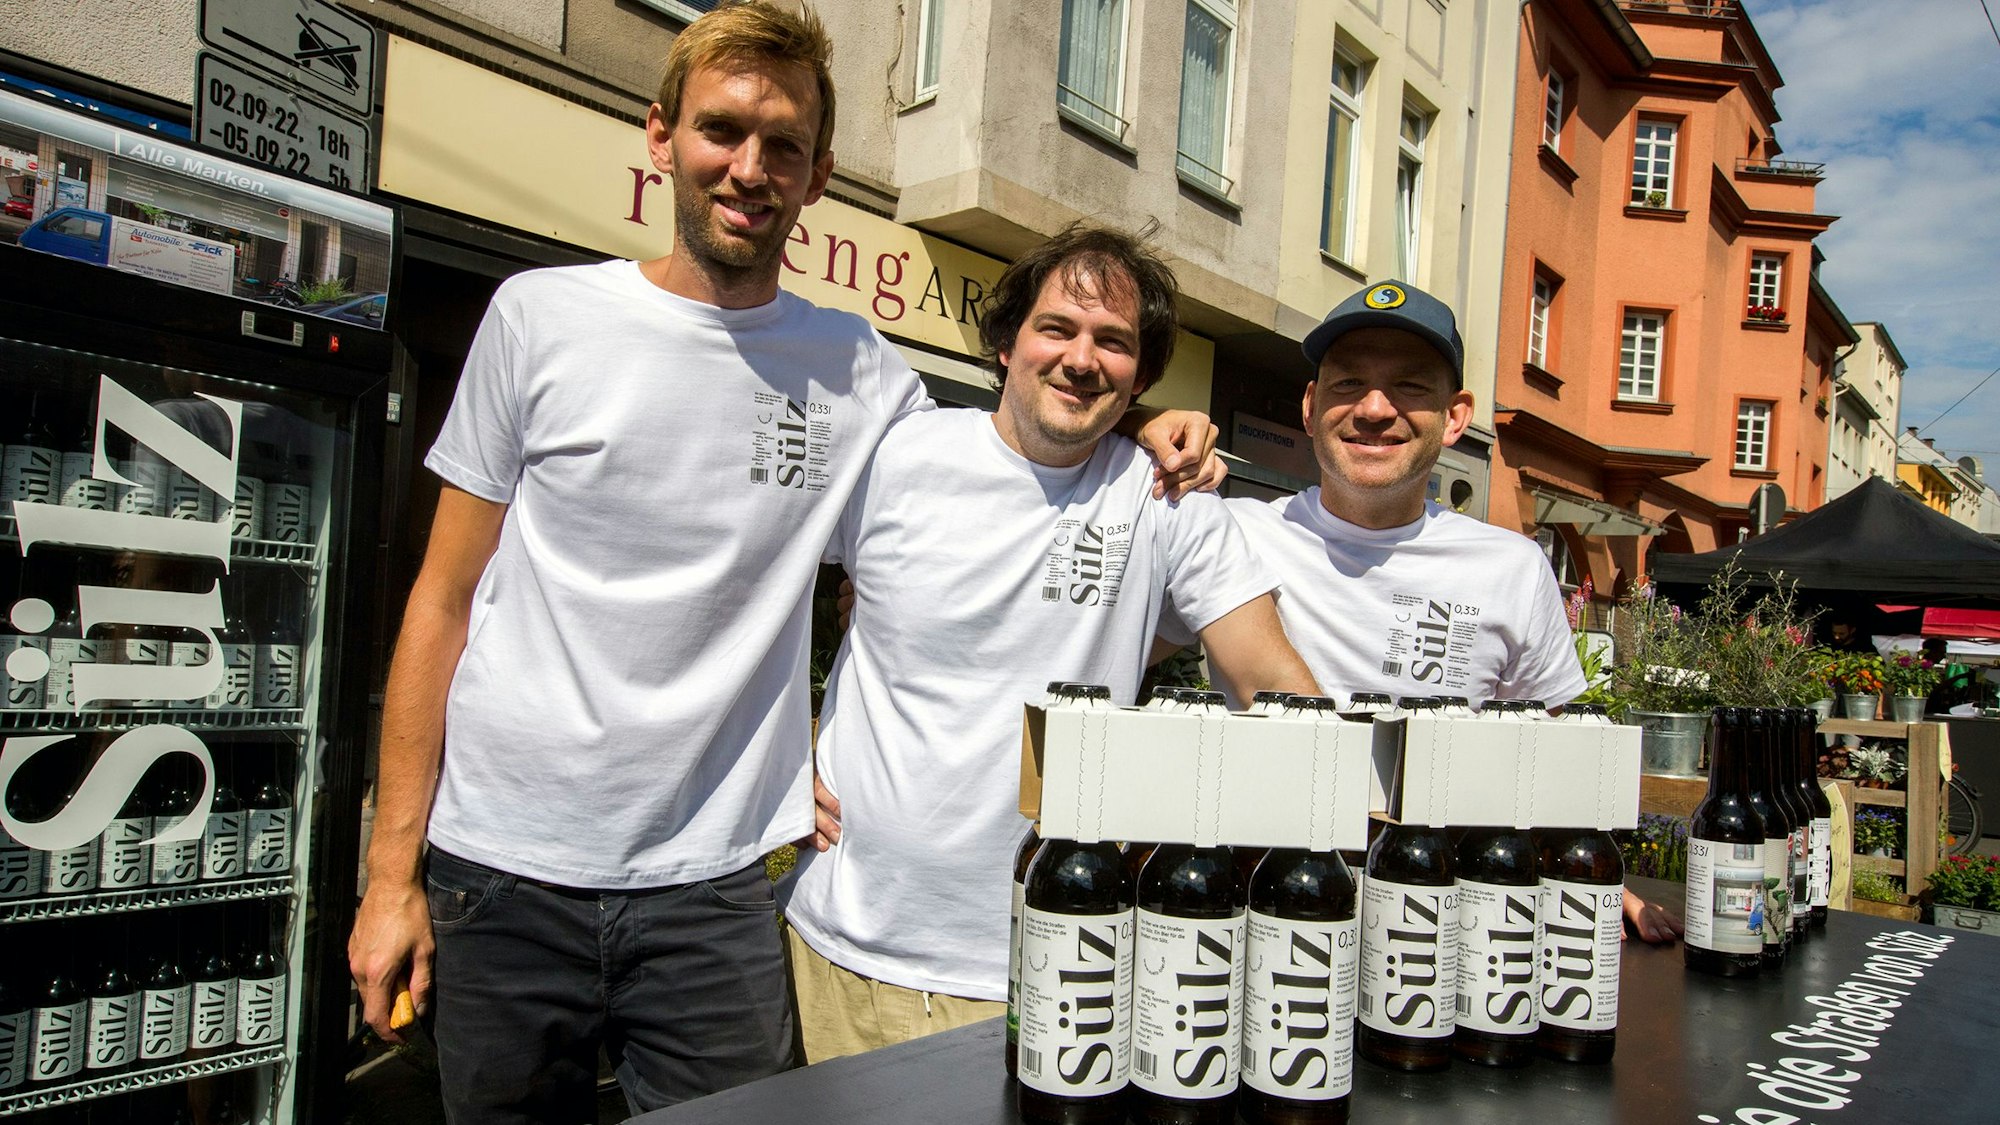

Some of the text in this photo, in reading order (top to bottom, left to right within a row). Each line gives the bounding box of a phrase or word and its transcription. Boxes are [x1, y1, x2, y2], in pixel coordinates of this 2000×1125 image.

[129, 143, 176, 167] Alle
[182, 157, 269, 195] Marken.
[318, 125, 350, 161] 18h
[131, 229, 181, 246] Automobile
[776, 398, 806, 489] Sülz
[1239, 423, 1295, 448] DRUCKPATRONEN
[275, 487, 301, 542] Sülz
[1069, 522, 1104, 606] Sülz
[0, 373, 243, 851] Sülz
[1410, 599, 1452, 685] Sülz
[227, 648, 252, 706] Sülz
[268, 648, 294, 704] Sülz
[113, 821, 144, 884] Sülz
[213, 815, 239, 875] Sülz
[261, 811, 286, 869] Sülz
[1384, 893, 1440, 1029] Sülz
[1486, 893, 1536, 1026] Sülz
[1541, 889, 1597, 1021] Sülz
[1850, 955, 1934, 986] von
[97, 1000, 129, 1064] Sülz
[145, 993, 175, 1055] Sülz
[198, 984, 227, 1045] Sülz
[247, 982, 274, 1041] Sülz
[1058, 925, 1117, 1086] Sülz
[1173, 929, 1234, 1088] Sülz
[1269, 929, 1333, 1090] Sülz
[1769, 980, 1913, 1063] Straßen
[39, 1009, 73, 1076] Sülz
[1746, 1057, 1862, 1111] die
